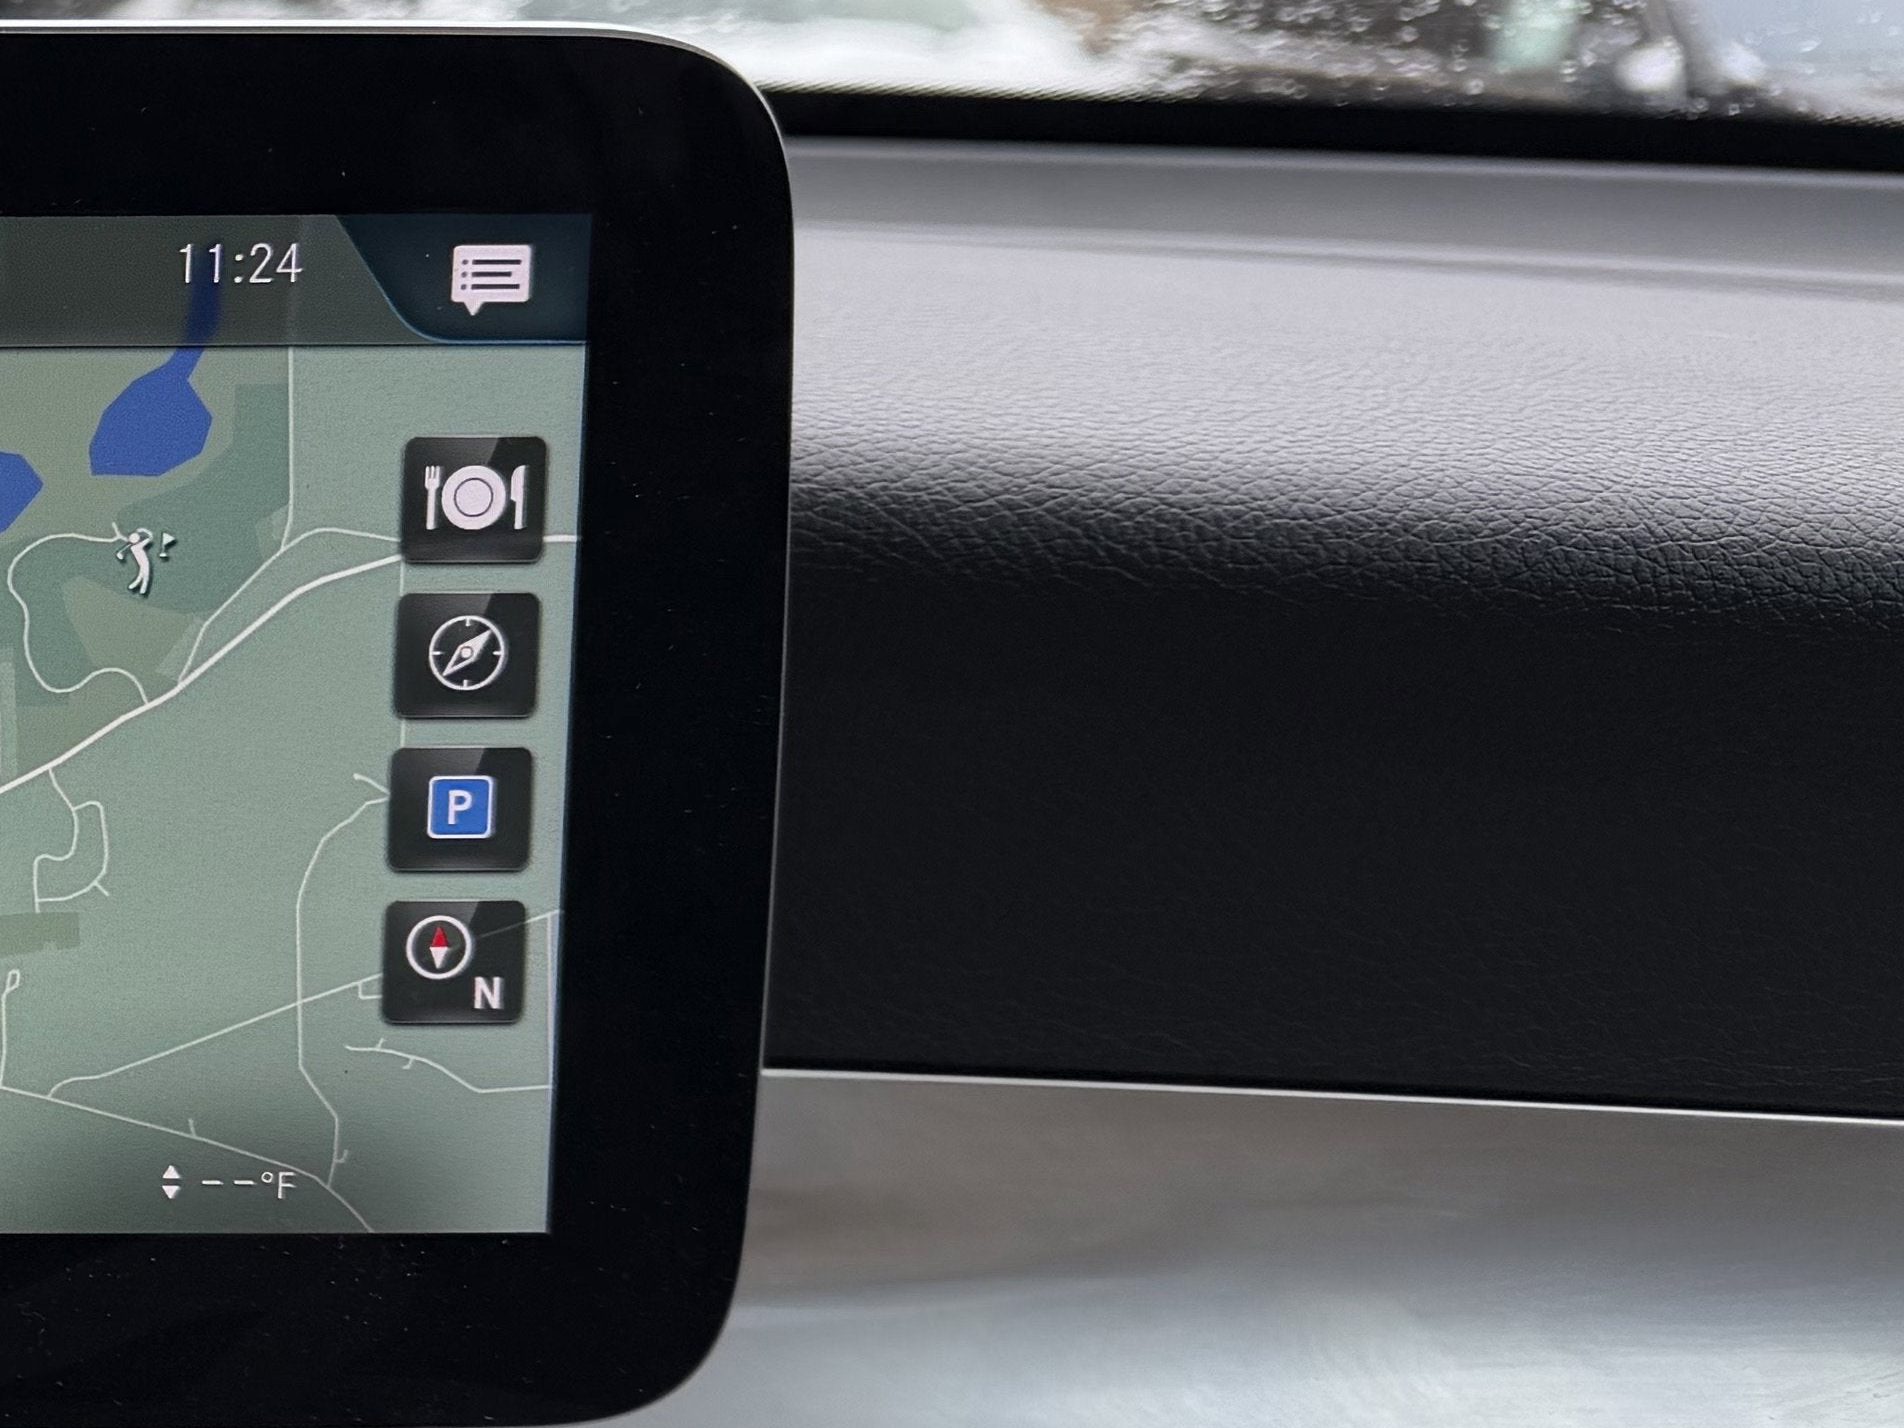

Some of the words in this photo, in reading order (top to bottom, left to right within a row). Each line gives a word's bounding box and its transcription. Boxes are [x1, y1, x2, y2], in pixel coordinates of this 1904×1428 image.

[179, 243, 303, 284] 11:24
[448, 789, 473, 824] P
[475, 977, 501, 1010] N
